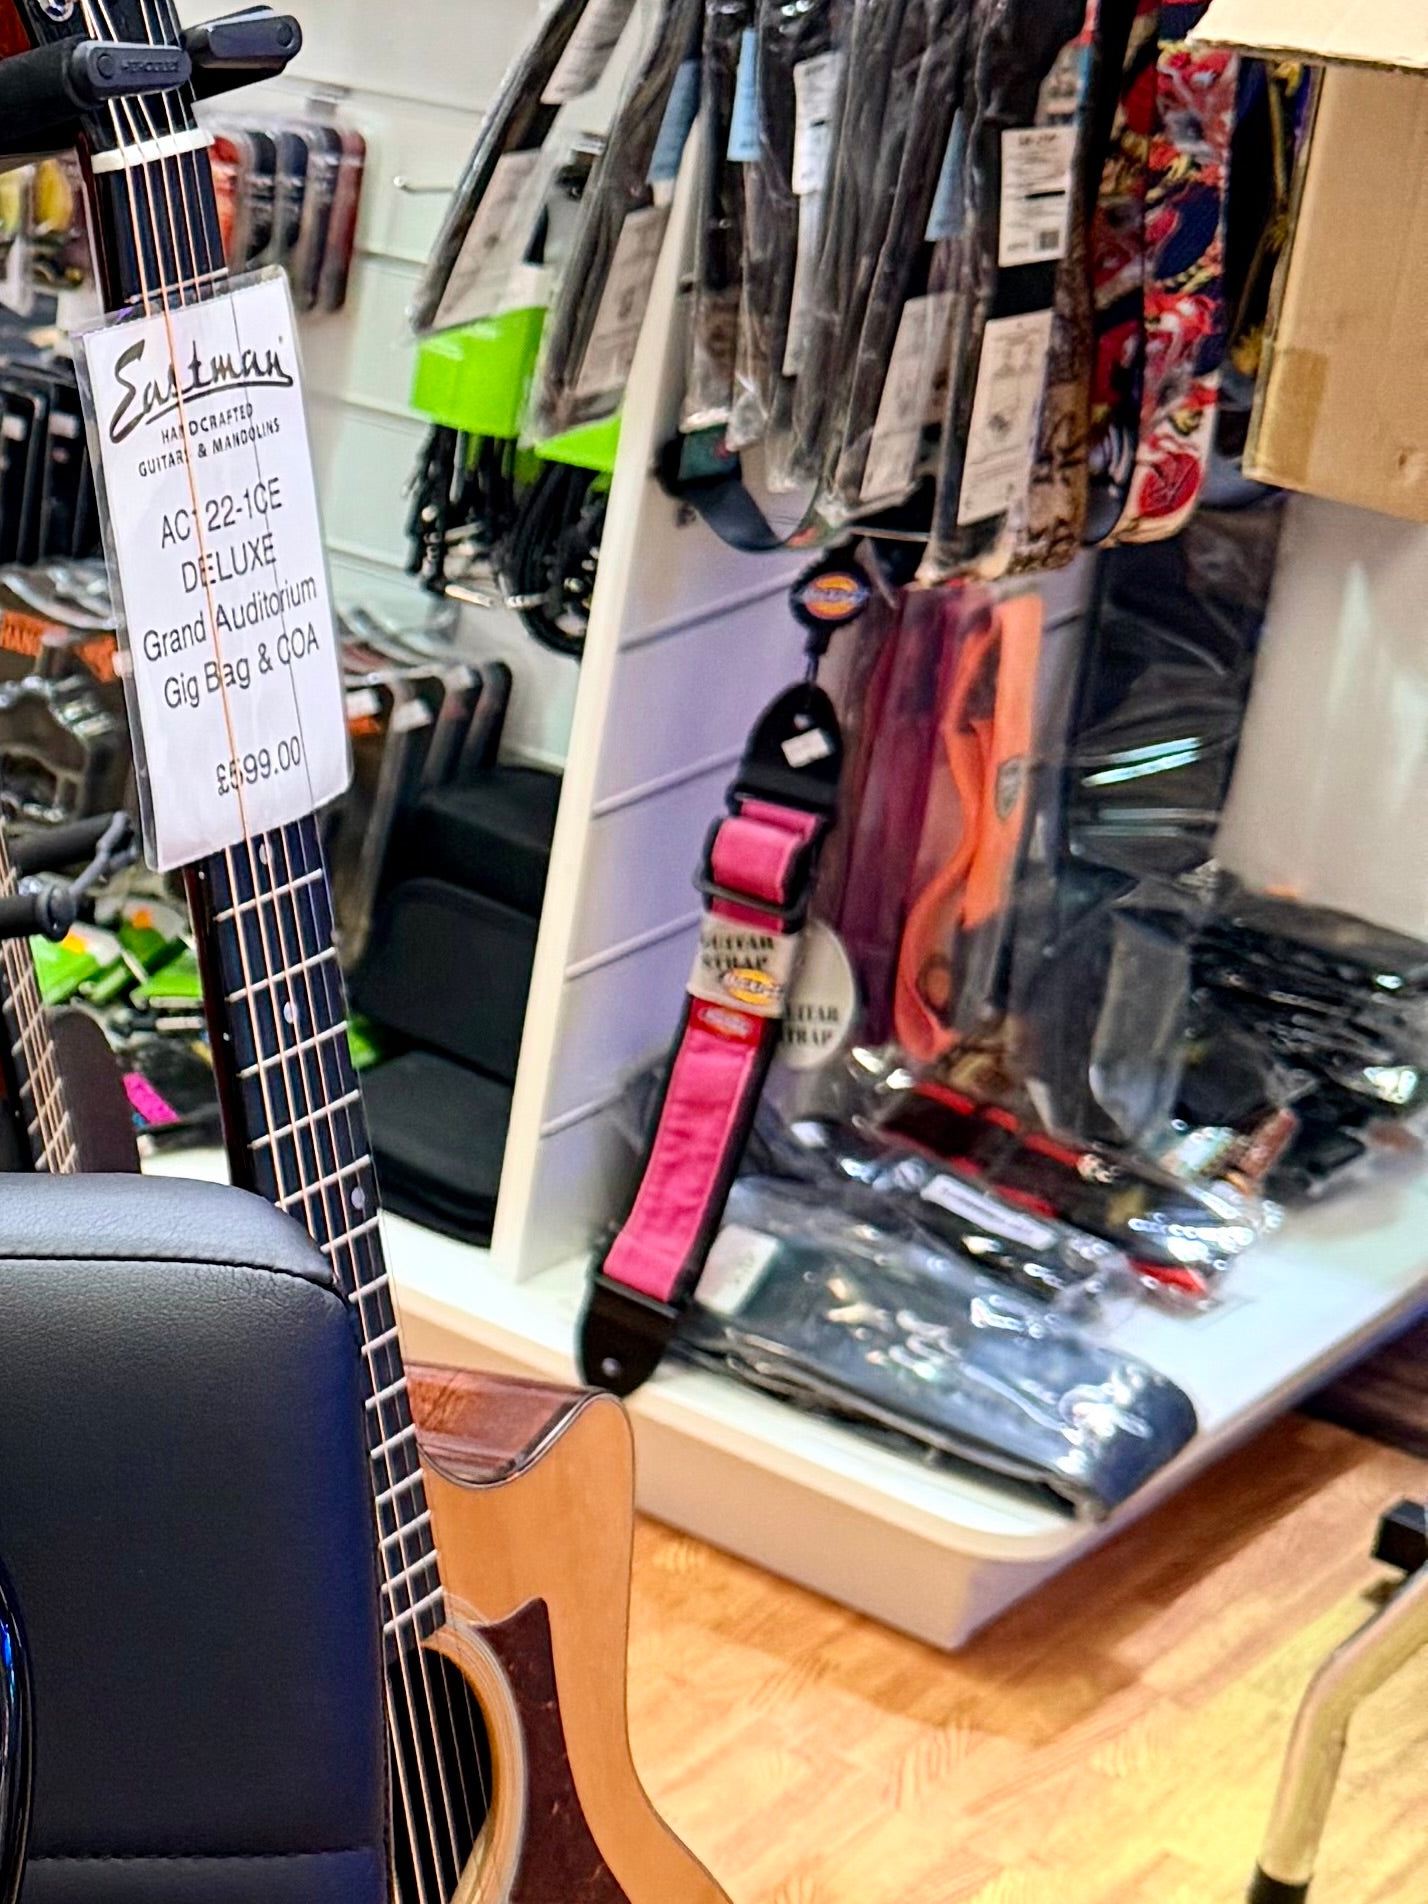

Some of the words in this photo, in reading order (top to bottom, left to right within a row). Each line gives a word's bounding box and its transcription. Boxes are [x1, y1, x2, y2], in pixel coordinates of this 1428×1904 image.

[109, 339, 294, 444] Eastman
[197, 442, 208, 459] &
[211, 416, 281, 456] MANDOLINS
[160, 476, 284, 550] AC22-1CE
[180, 532, 279, 595] DELUXE
[143, 610, 208, 664] Grand
[214, 574, 318, 634] Auditorium
[163, 671, 202, 710] Gig
[203, 655, 253, 695] Bag
[257, 641, 275, 676] &
[276, 621, 321, 667] COA
